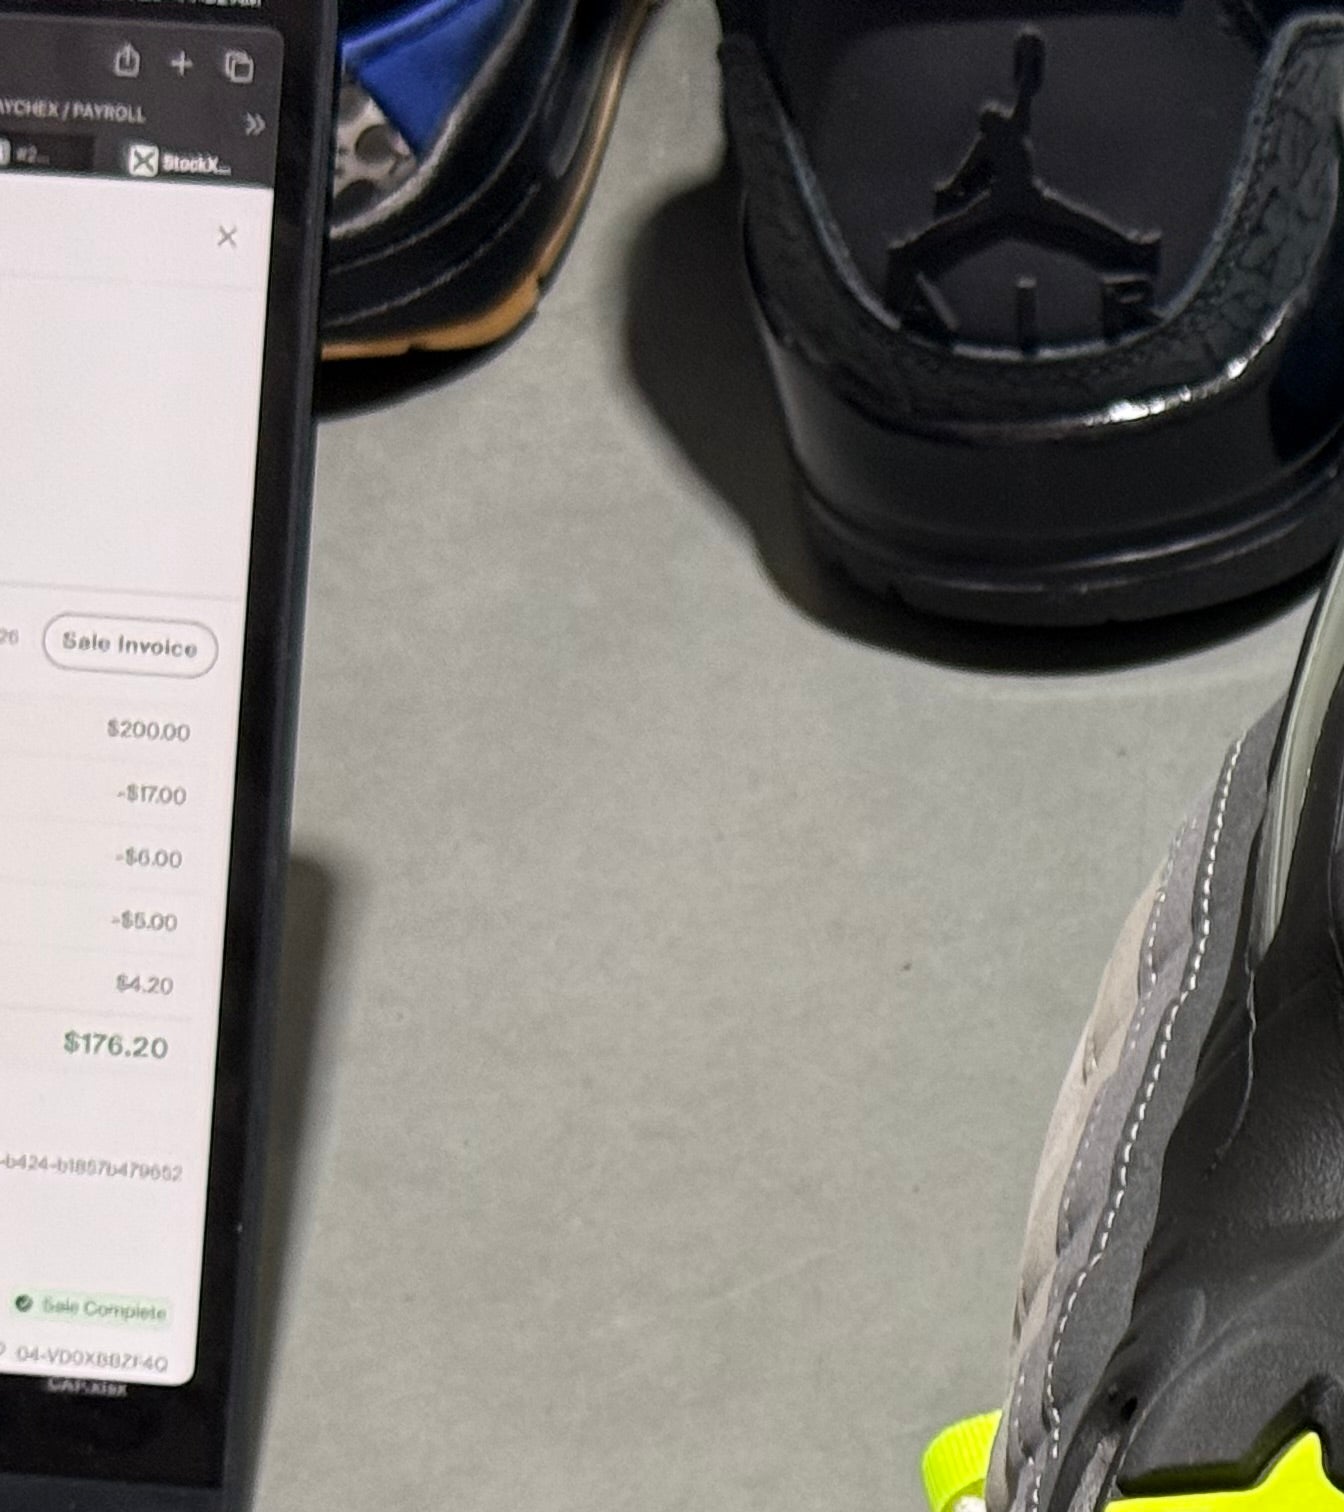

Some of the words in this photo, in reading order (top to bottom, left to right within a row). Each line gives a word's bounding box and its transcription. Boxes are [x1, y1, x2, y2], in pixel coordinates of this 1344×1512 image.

[72, 101, 147, 124] PAYROLL
[62, 631, 111, 652] Sale
[118, 635, 198, 658] Invoice
[106, 718, 192, 742] $200.00
[117, 783, 188, 806] -$17.00
[116, 973, 174, 996] $4.20
[63, 1030, 169, 1059] $176.20
[42, 1296, 79, 1315] Sale
[84, 1299, 167, 1322] Complete
